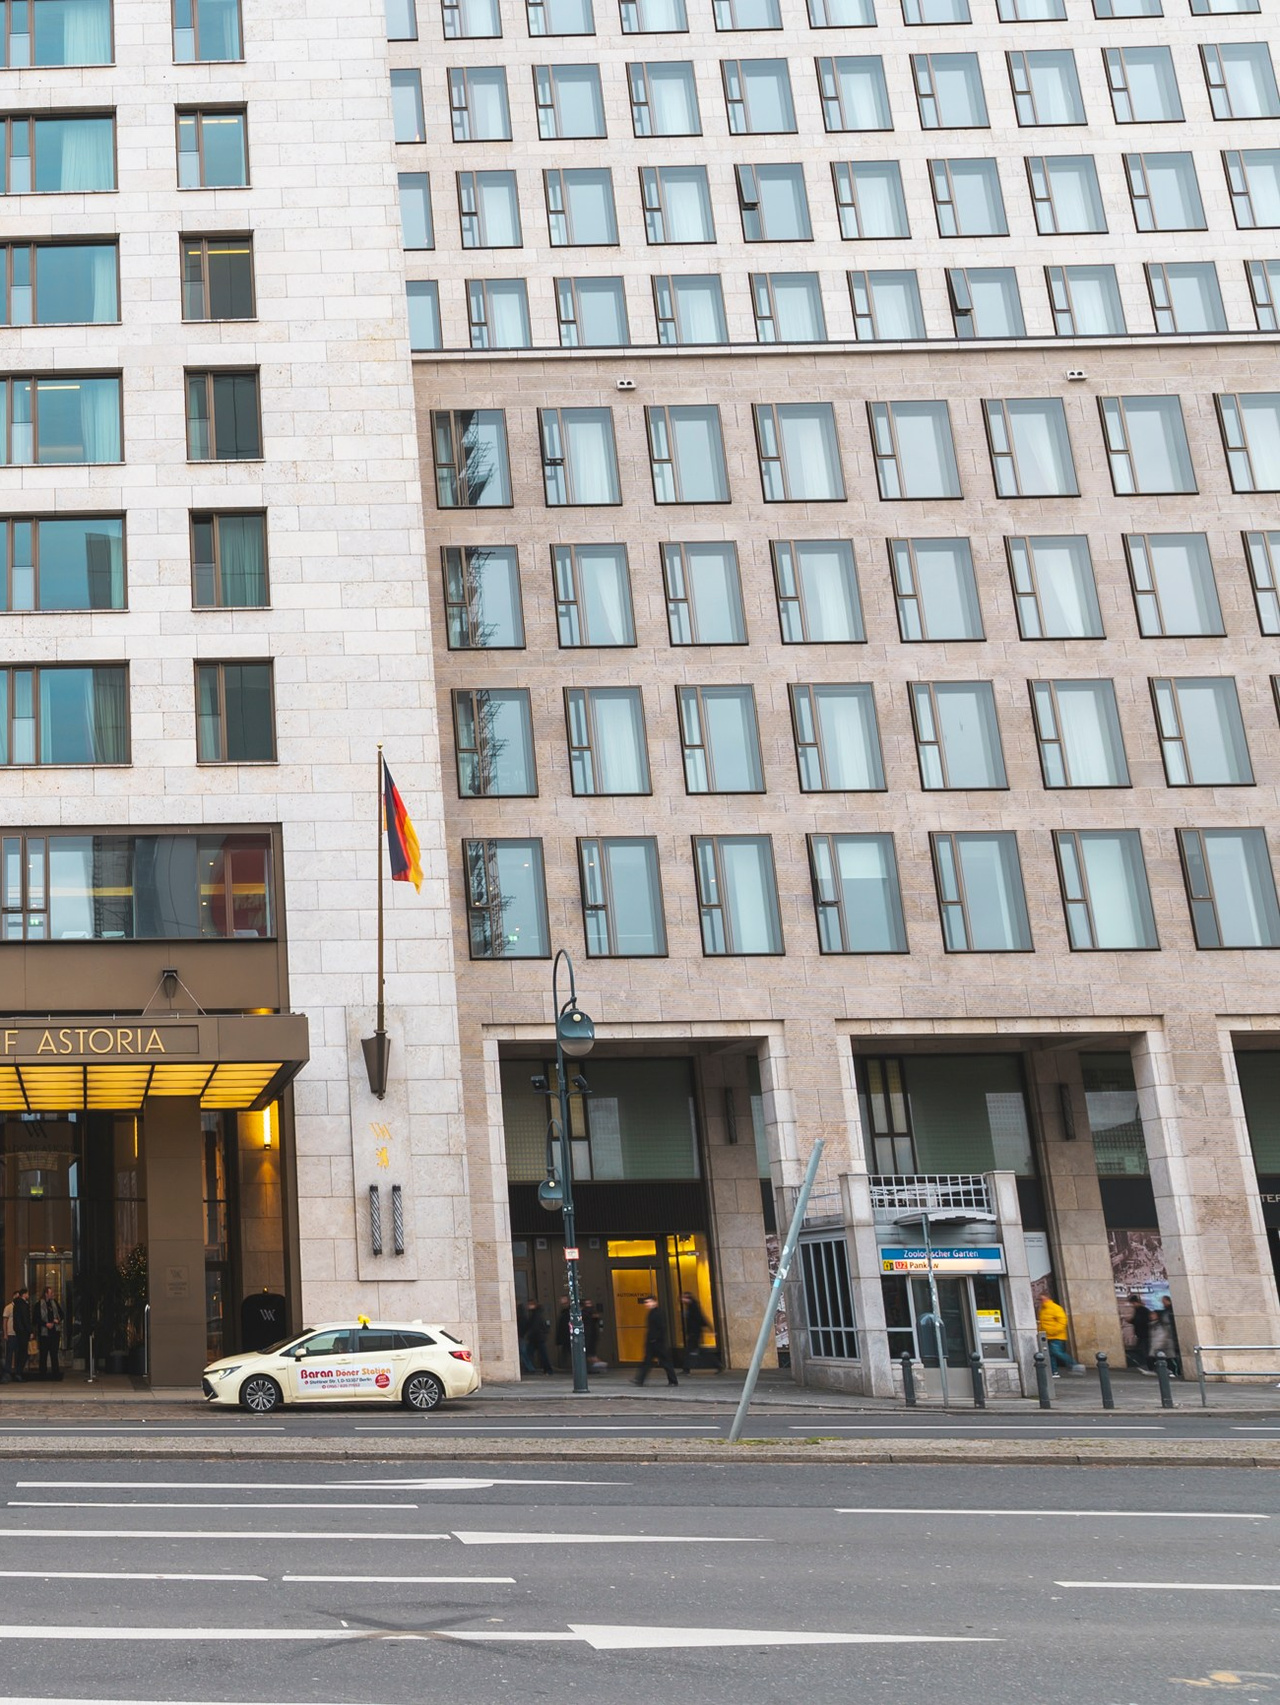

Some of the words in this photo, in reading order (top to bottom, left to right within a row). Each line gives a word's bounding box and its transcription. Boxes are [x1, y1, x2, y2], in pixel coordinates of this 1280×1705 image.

[36, 1028, 166, 1054] ASTORIA
[952, 1249, 979, 1257] Garten
[896, 1261, 907, 1269] U2
[909, 1261, 939, 1269] Pankw
[300, 1369, 333, 1379] Baran
[361, 1367, 391, 1375] Station
